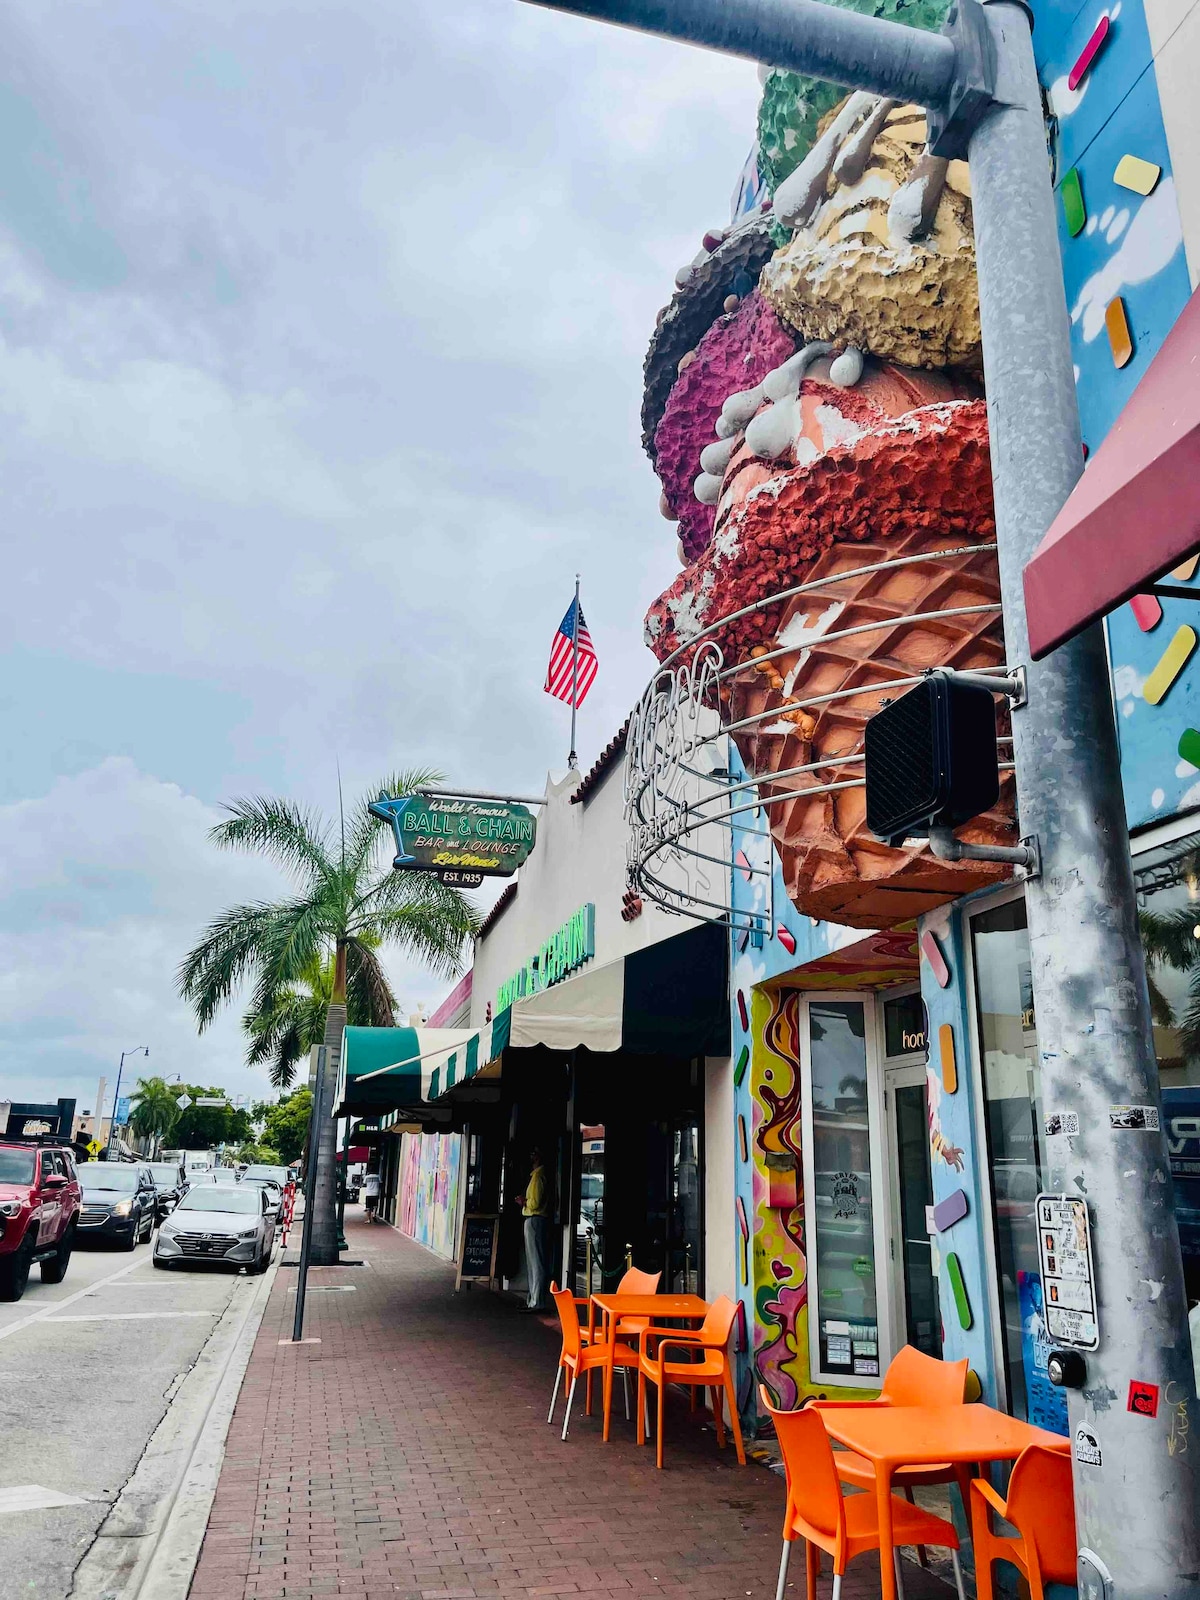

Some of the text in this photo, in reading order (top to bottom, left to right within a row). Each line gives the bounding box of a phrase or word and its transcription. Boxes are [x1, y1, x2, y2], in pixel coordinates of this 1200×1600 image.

[429, 799, 510, 818] World Famous
[403, 811, 533, 841] BALL & CHAIN
[414, 835, 521, 855] BAR and LOUNGE
[432, 851, 500, 868] Live Music
[443, 872, 482, 884] EST. 1935
[830, 1172, 858, 1182] SERVED
